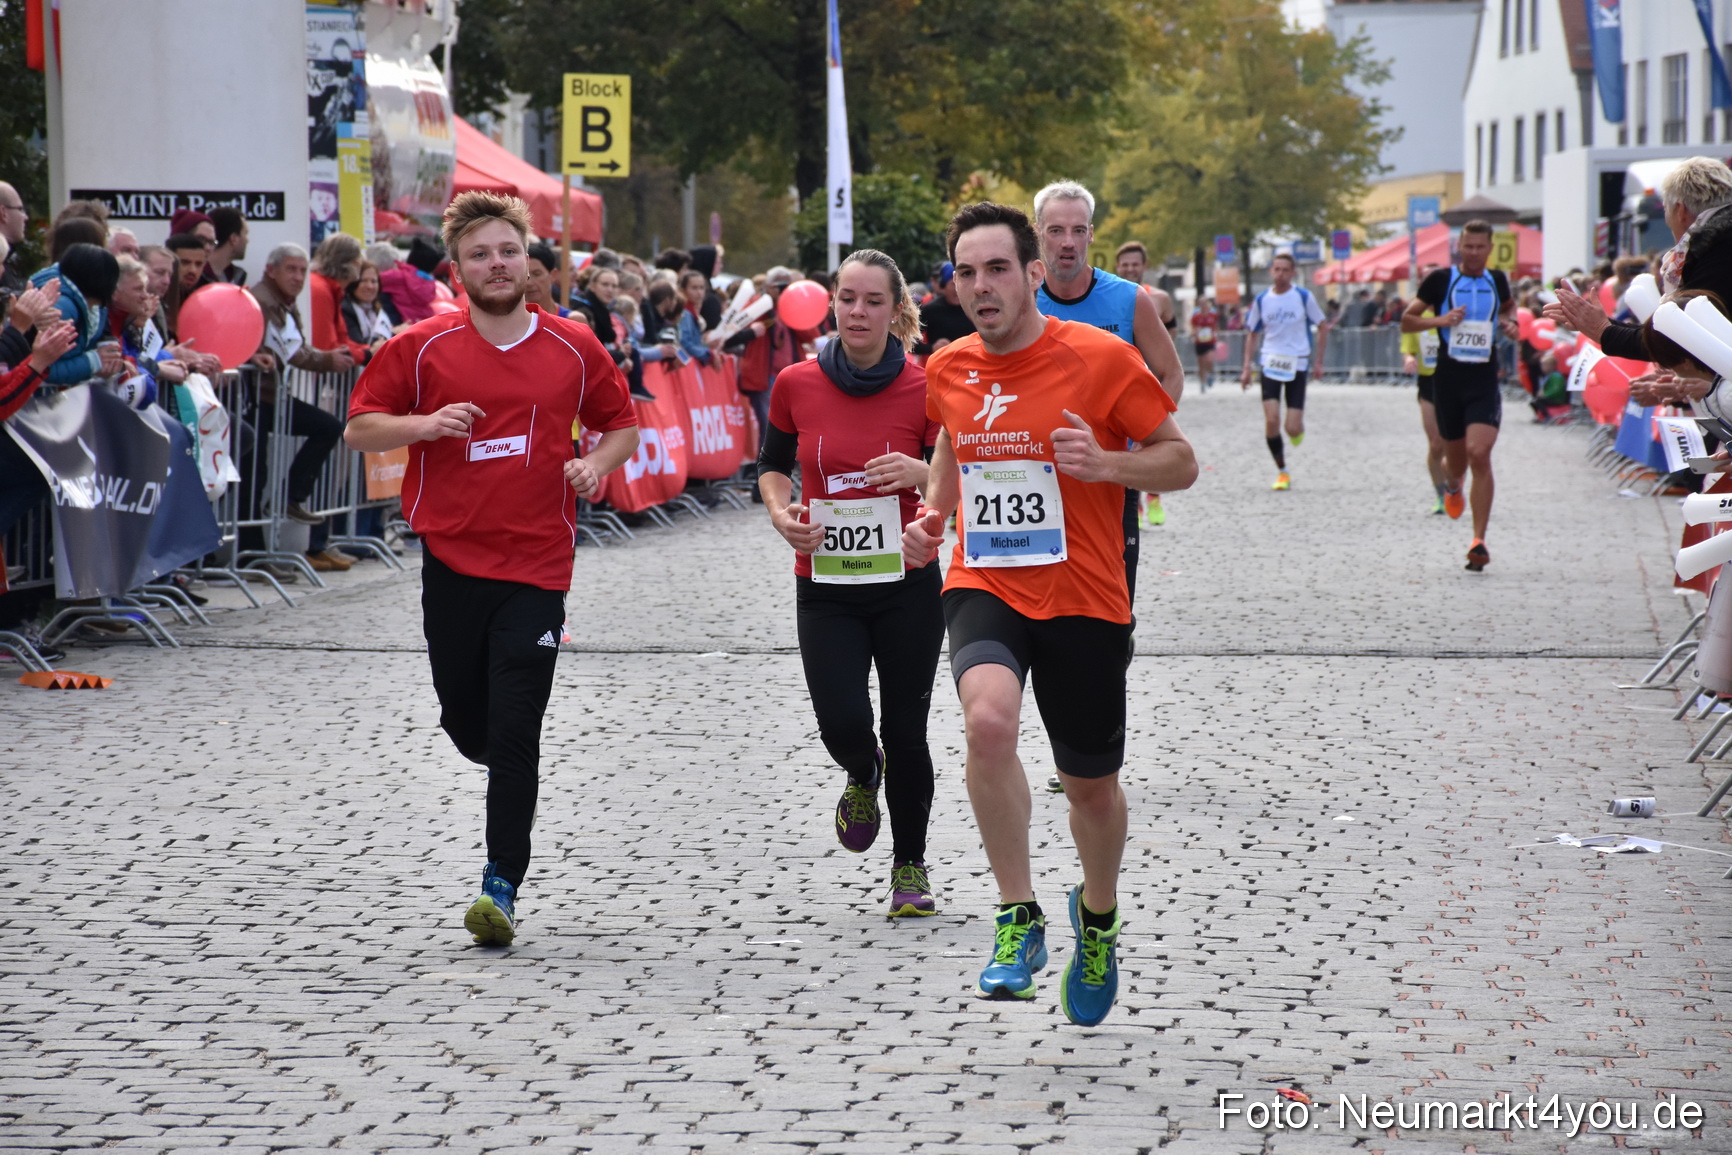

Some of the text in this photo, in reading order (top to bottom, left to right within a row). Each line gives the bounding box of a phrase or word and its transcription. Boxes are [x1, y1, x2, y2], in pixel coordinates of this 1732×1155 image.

[572, 79, 622, 97] Block
[581, 106, 613, 153] B
[1498, 243, 1512, 263] D
[1456, 333, 1487, 346] 2706
[957, 431, 1031, 449] funrunners
[485, 442, 511, 454] DEHN
[976, 441, 1044, 457] neumarkt
[842, 476, 866, 485] DEHN
[993, 470, 1027, 480] BOCK
[841, 506, 874, 516] BOCK
[974, 492, 1046, 525] 2133
[823, 523, 885, 552] 5021
[990, 536, 1030, 549] Michael
[842, 560, 872, 569] Melina
[537, 640, 557, 648] adidas
